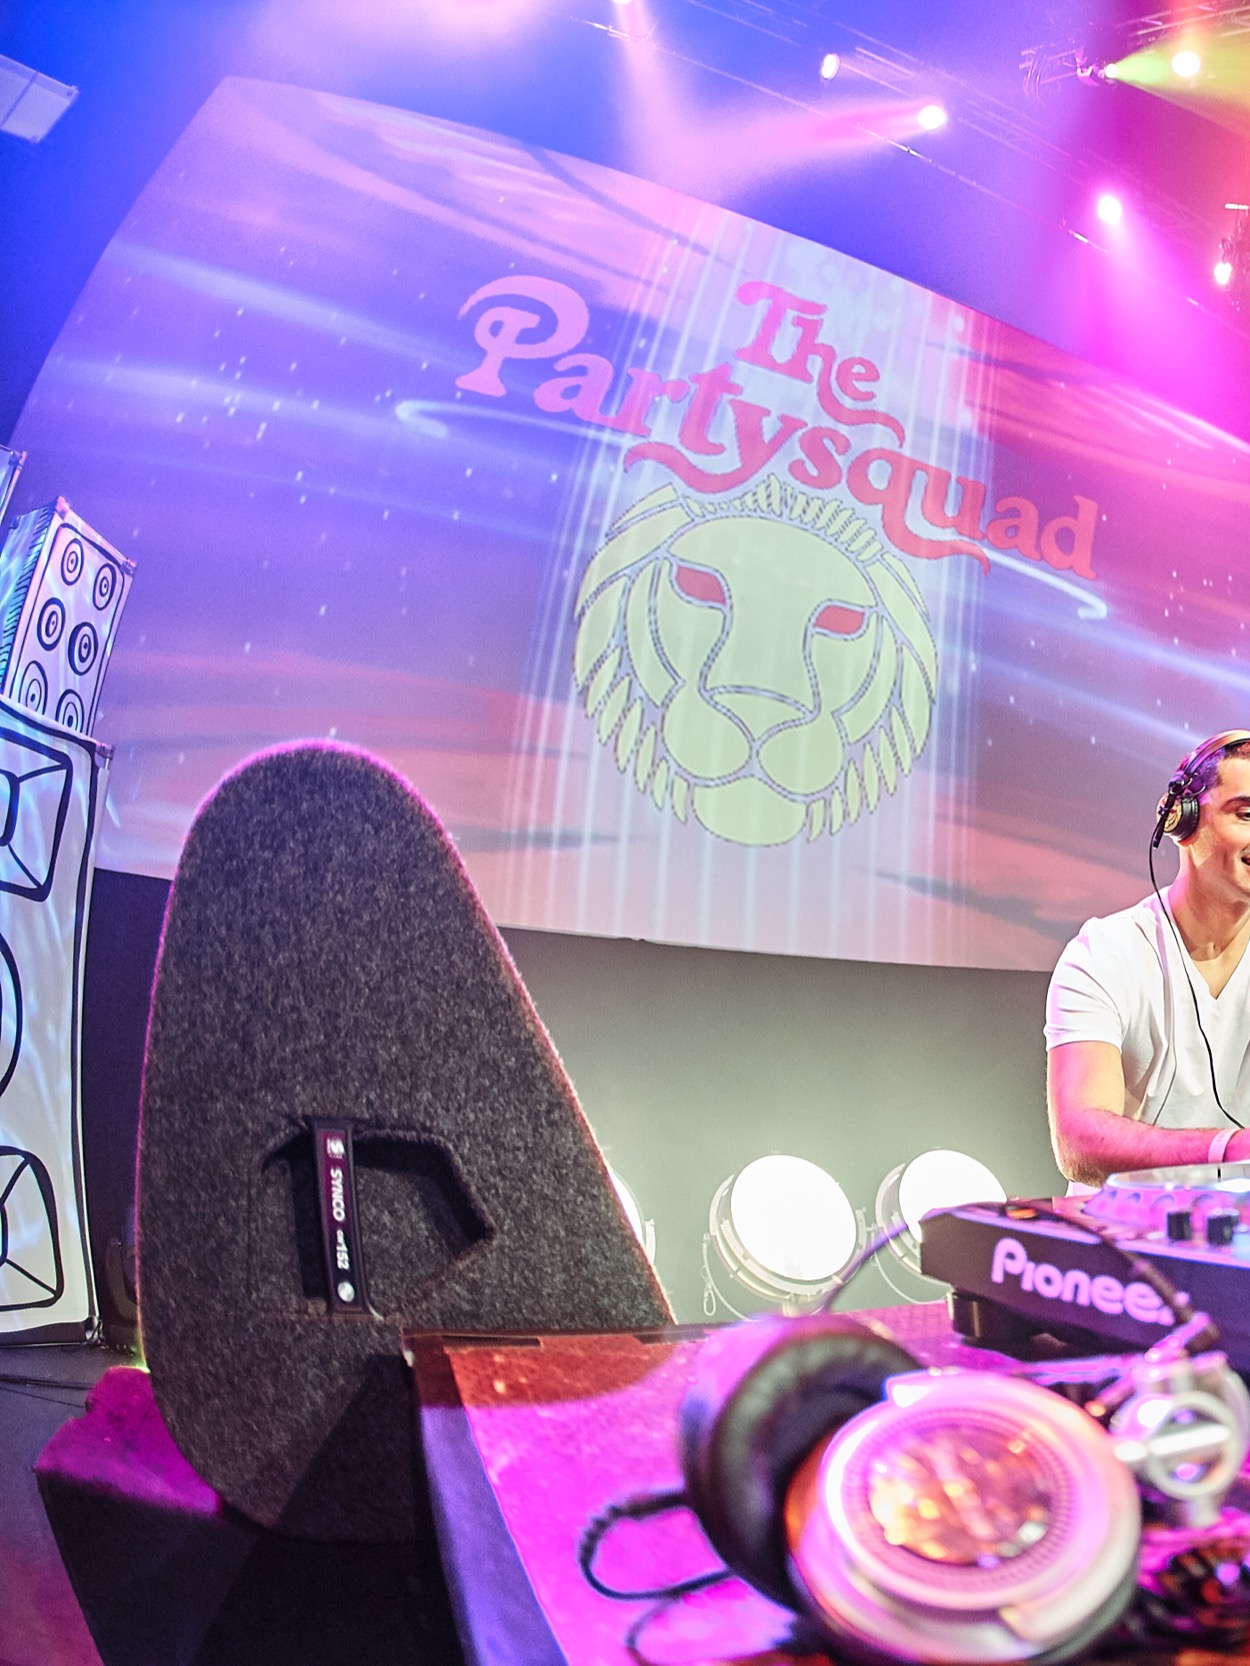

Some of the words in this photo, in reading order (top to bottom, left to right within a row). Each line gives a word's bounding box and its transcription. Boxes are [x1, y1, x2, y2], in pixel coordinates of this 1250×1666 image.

[455, 274, 1099, 581] Partysquad
[736, 279, 906, 448] The
[330, 1167, 345, 1222] SYNCO
